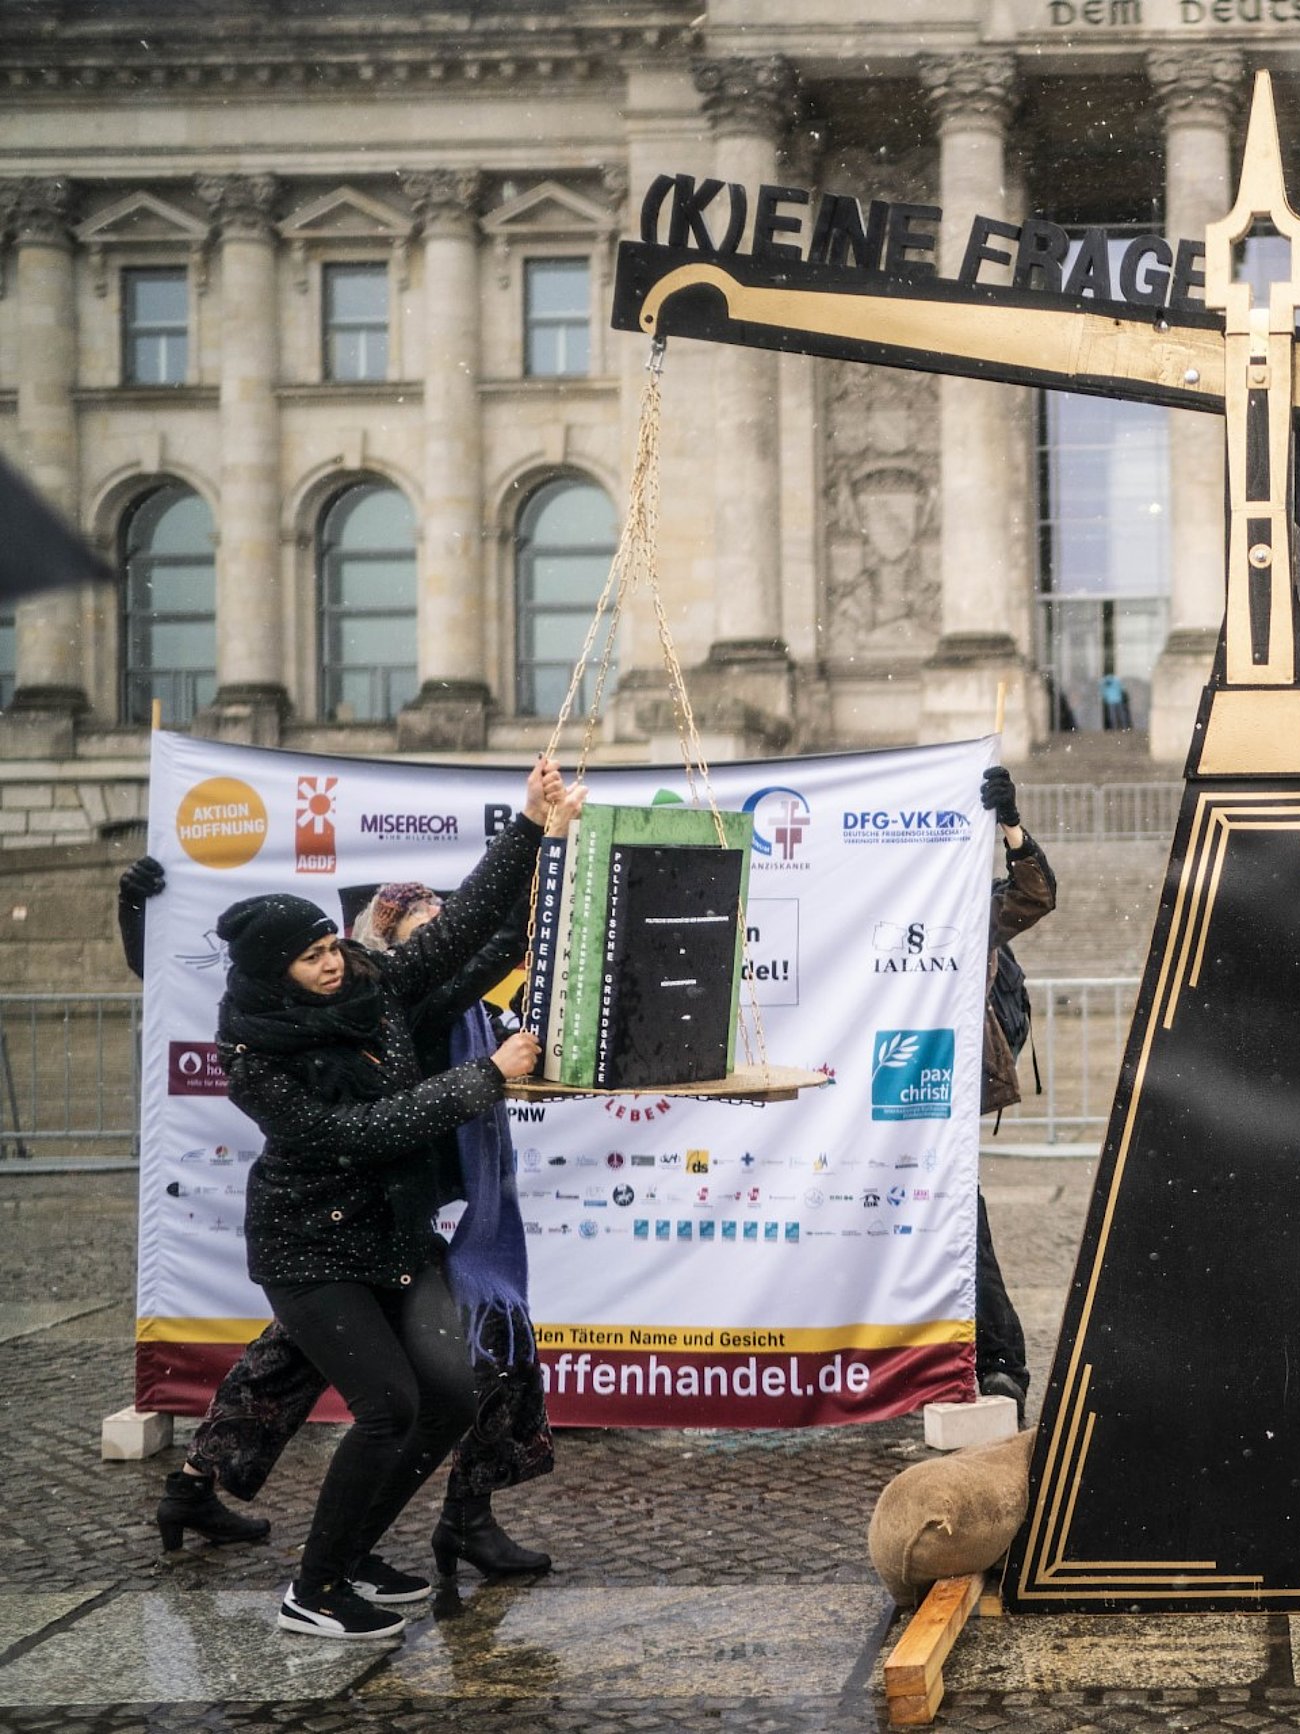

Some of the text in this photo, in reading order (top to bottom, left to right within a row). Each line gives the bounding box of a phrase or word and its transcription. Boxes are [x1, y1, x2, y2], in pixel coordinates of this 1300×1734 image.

[641, 173, 943, 278] (K)EINE
[958, 215, 1206, 308] FRAGE
[192, 803, 249, 821] AKTION
[843, 811, 933, 830] DFG-VK
[180, 818, 265, 840] HOFFNUNG
[361, 814, 459, 834] MISEREOR
[297, 855, 336, 870] AGDF
[751, 862, 811, 870] ANZISKANER
[606, 852, 622, 962] POLITISCHE
[530, 845, 561, 1037] MENSCHENRECH
[740, 960, 788, 981] del!
[920, 1067, 952, 1087] pax
[900, 1083, 950, 1103] christi
[507, 1107, 546, 1123] PNW
[604, 1098, 672, 1122] LEBEN
[535, 1328, 786, 1348] den Tätern Name und Gesicht
